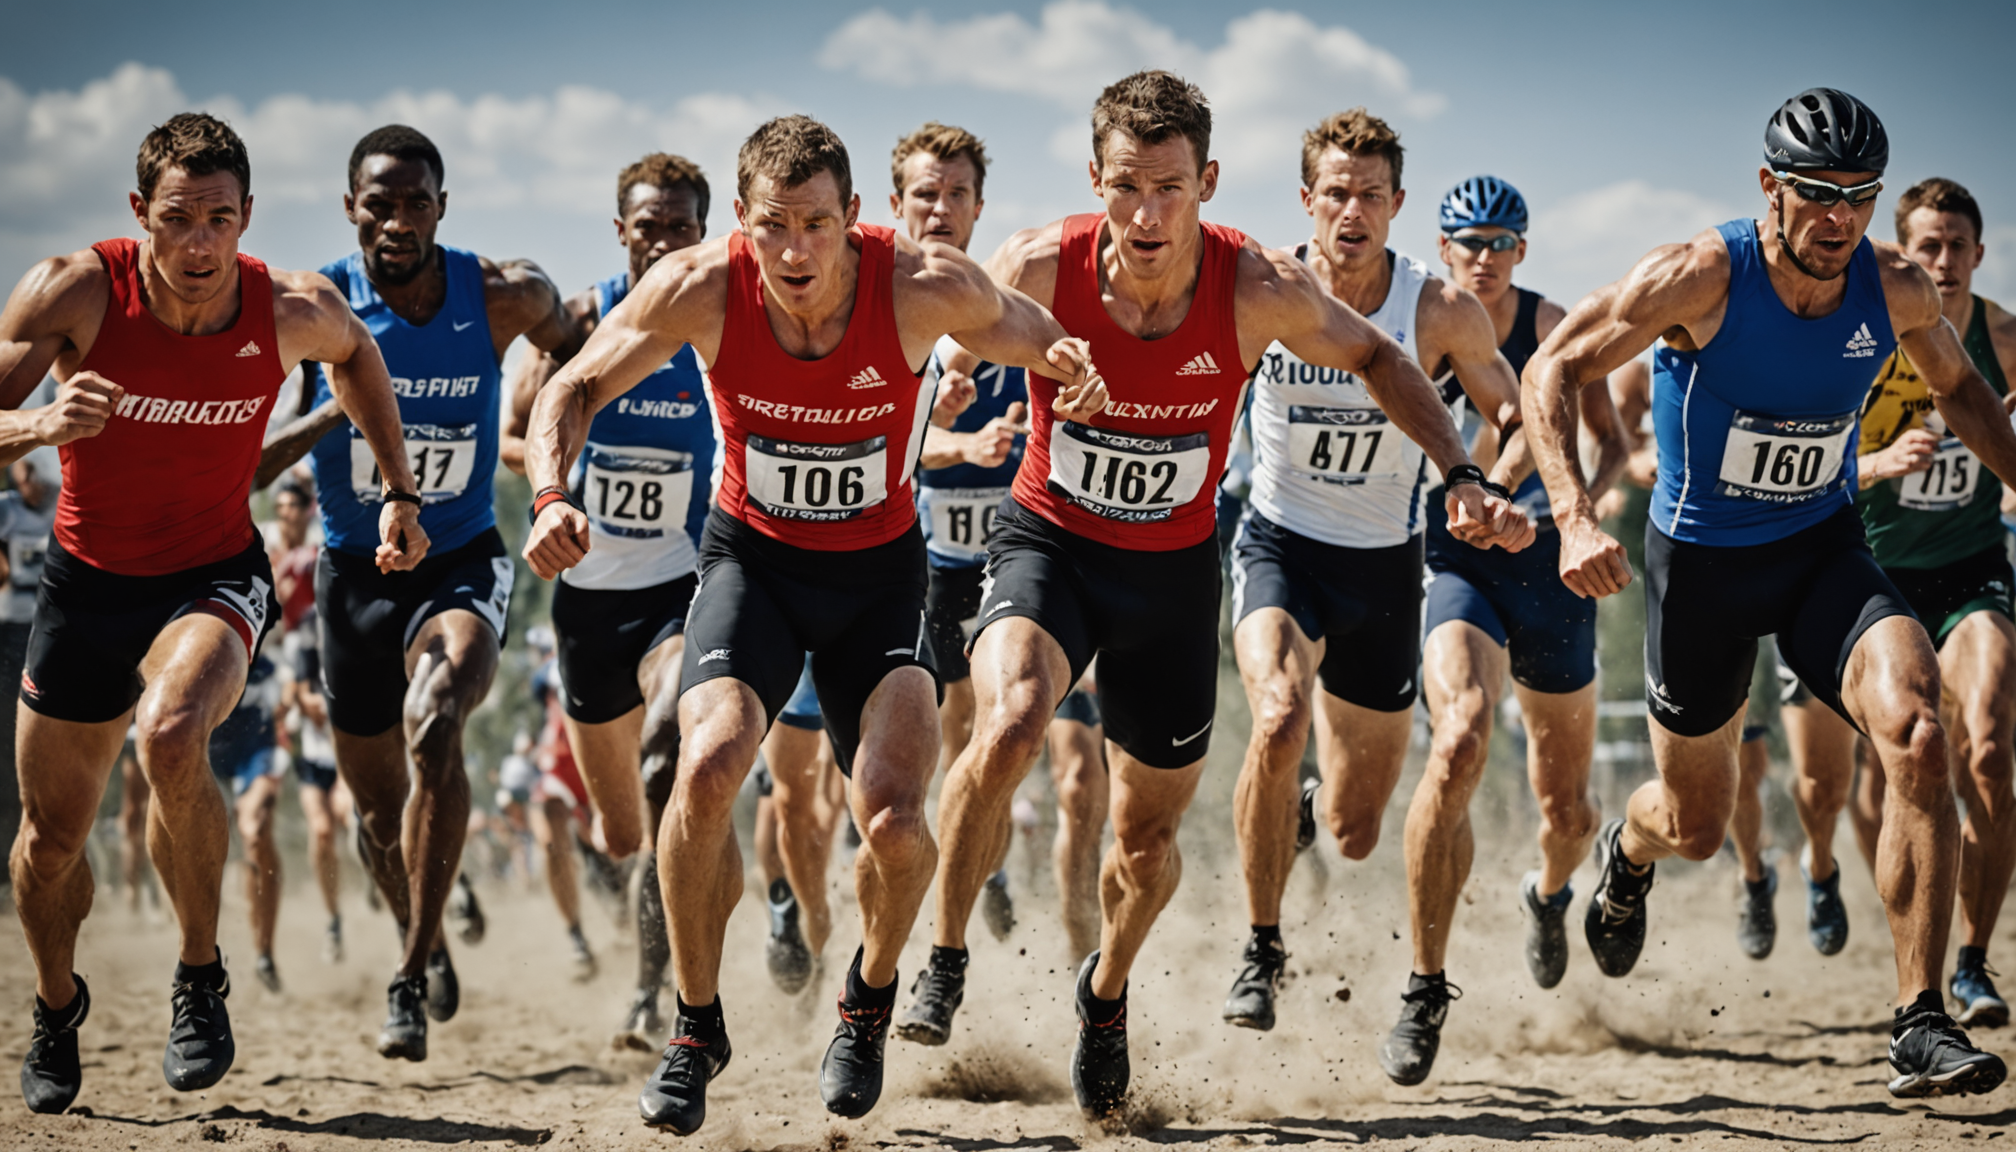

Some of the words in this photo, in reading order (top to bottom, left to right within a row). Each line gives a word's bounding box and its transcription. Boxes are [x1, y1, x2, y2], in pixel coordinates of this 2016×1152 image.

[778, 465, 865, 507] 106
[1751, 441, 1825, 486] 160
[596, 476, 663, 521] 128
